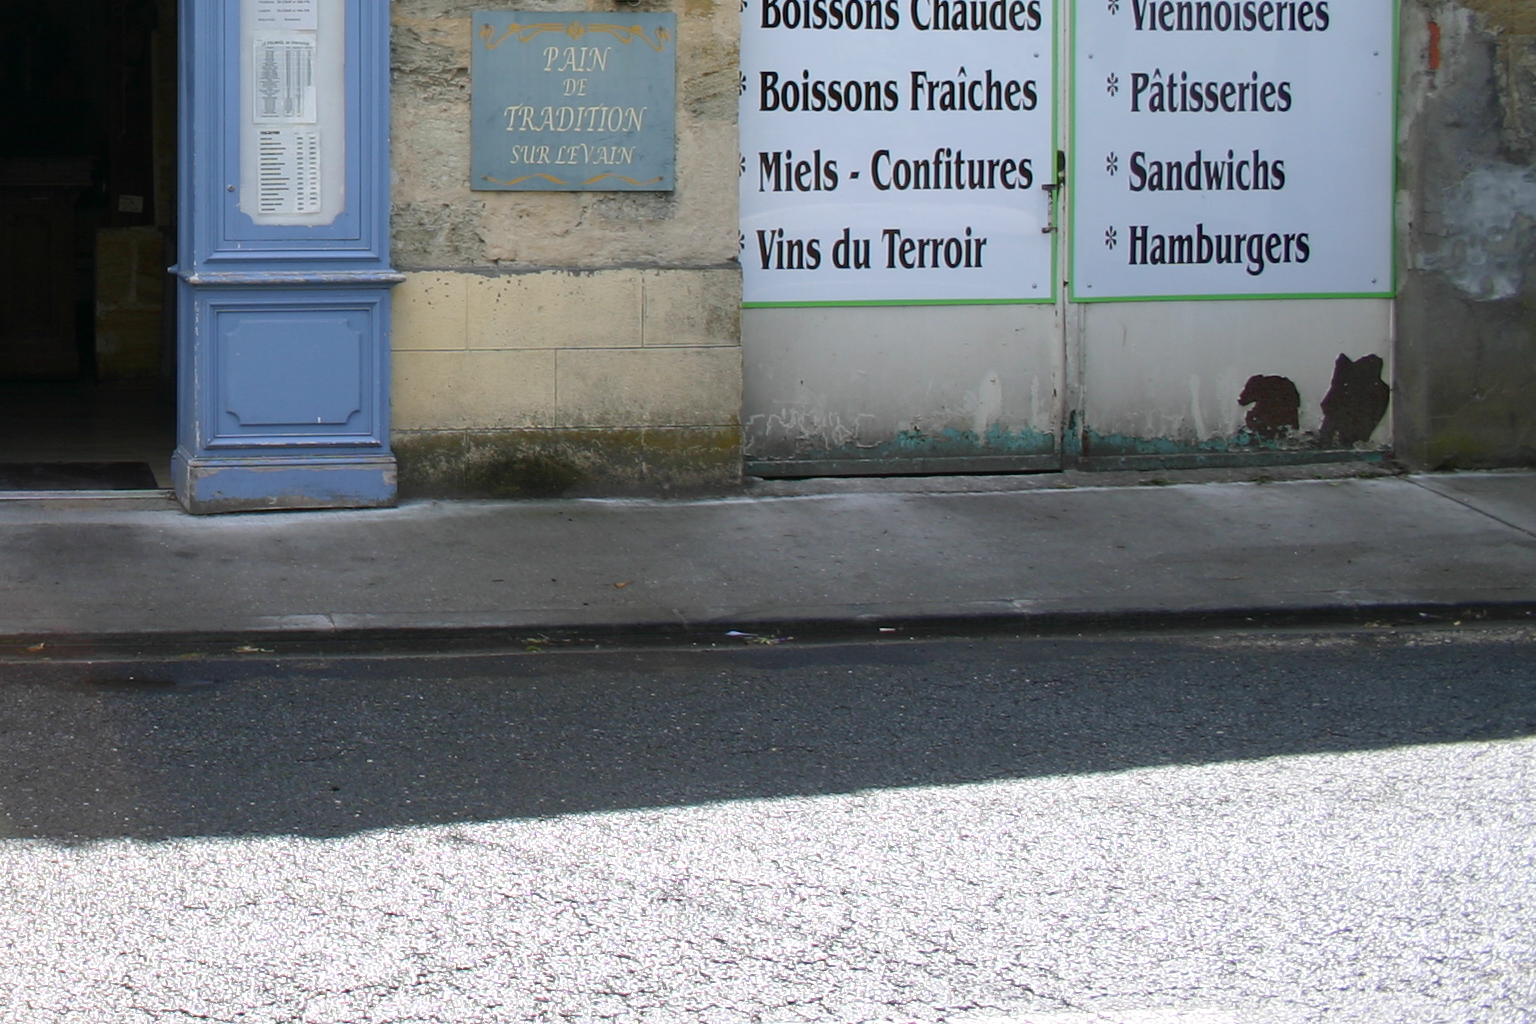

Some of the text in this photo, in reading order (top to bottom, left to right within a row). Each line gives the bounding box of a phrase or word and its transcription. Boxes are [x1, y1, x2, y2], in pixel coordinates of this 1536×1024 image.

[543, 46, 611, 72] PAIN
[563, 78, 587, 96] DE
[759, 67, 1038, 112] Boissons Fraîches
[1130, 69, 1292, 114] Pâtisseries
[504, 103, 647, 132] TRADITION
[510, 144, 636, 164] SUR LEVAIN
[758, 149, 838, 192] Miels
[870, 147, 1033, 191] Confitures
[1128, 150, 1286, 192] Sandwichs
[757, 226, 987, 271] Vins du Terroir
[1128, 225, 1311, 275] Hamburgers
